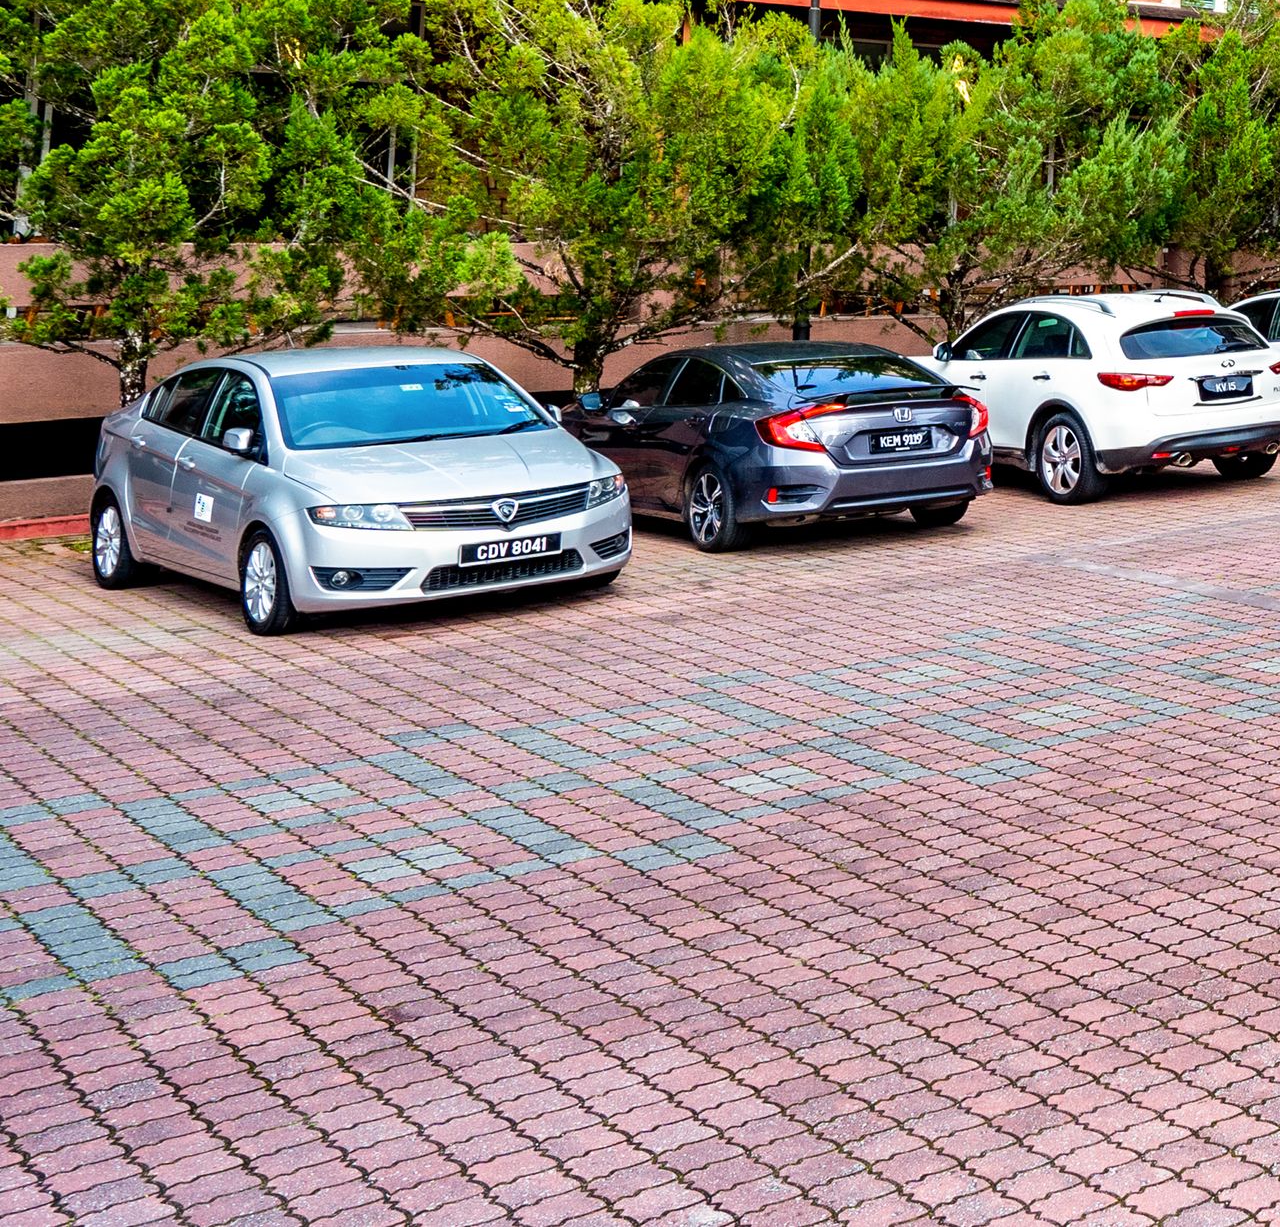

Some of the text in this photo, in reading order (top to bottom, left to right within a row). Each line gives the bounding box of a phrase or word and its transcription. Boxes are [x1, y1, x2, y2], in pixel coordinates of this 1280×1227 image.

[1215, 382, 1228, 393] KV
[879, 432, 923, 448] KEM 9119
[476, 536, 547, 560] CDV 8041
